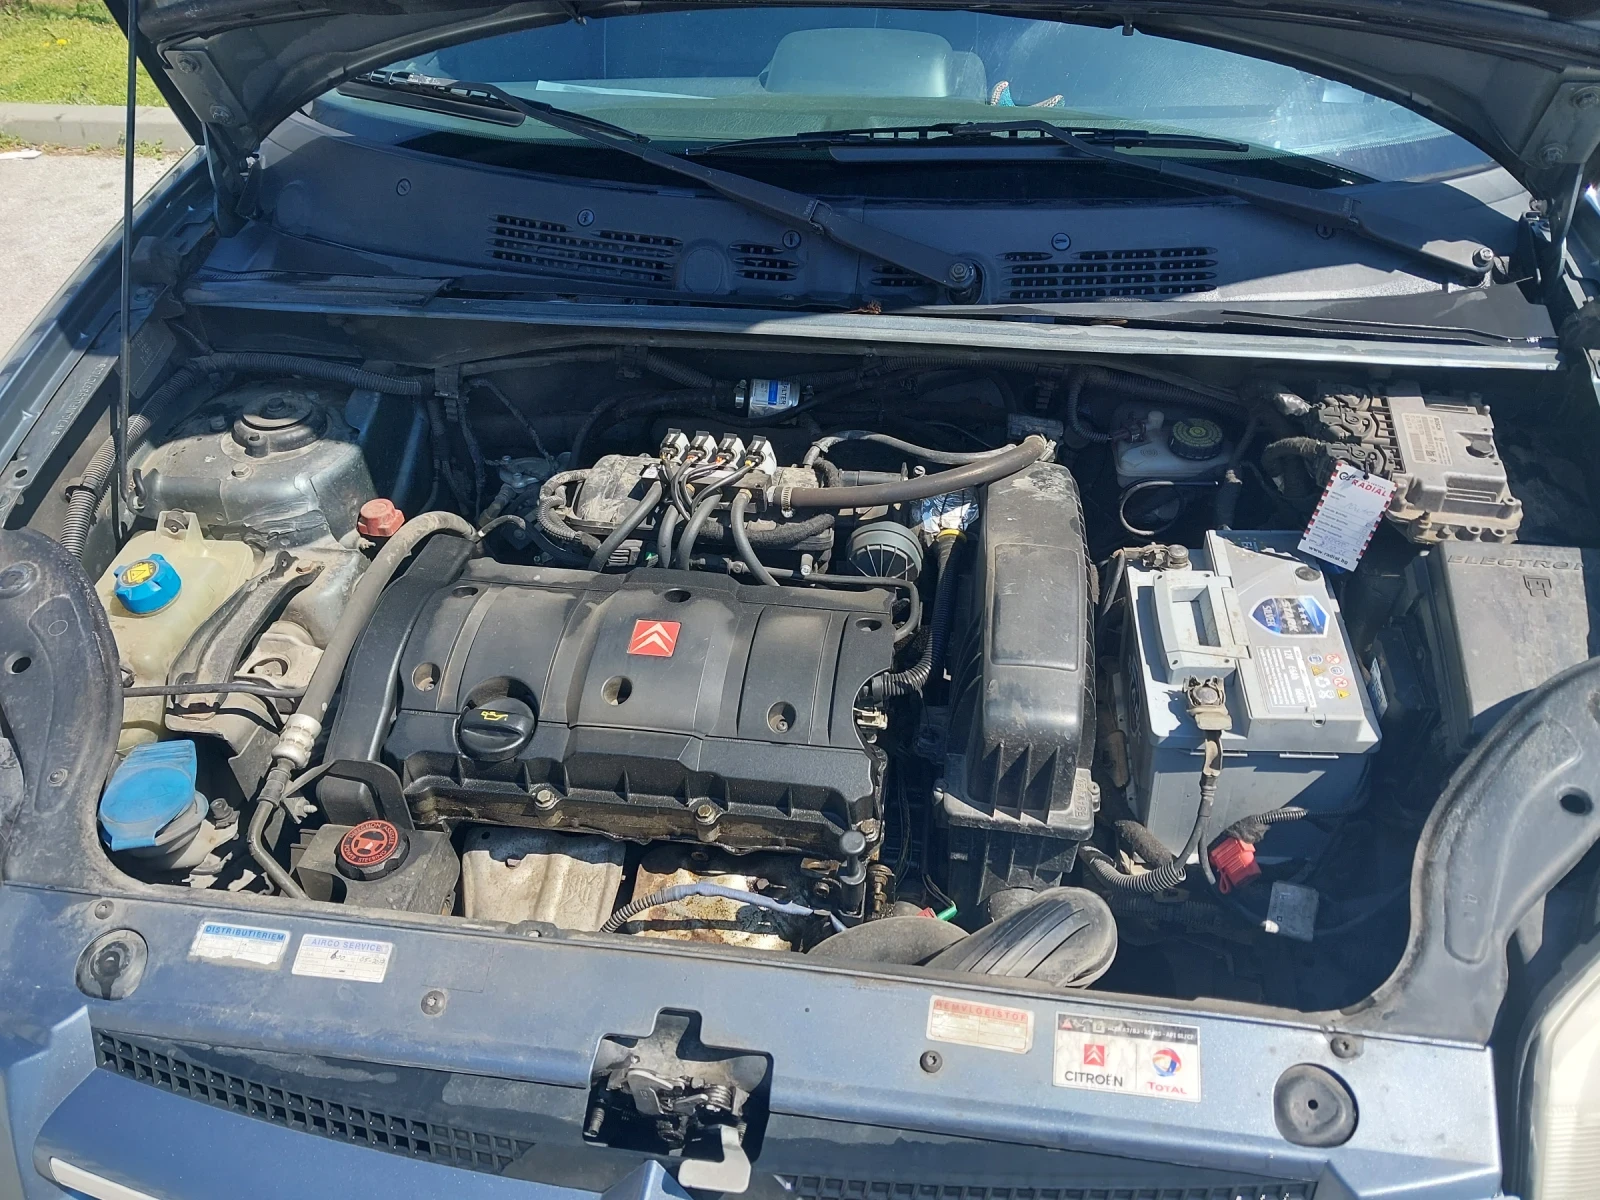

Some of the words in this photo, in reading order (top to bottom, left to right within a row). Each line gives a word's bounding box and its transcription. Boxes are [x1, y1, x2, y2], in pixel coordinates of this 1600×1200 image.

[1351, 479, 1388, 497] RADIAL
[1308, 546, 1349, 566] www.radial.bg
[1262, 605, 1277, 628] SILVER
[1281, 598, 1300, 633] STARK
[205, 925, 285, 941] DISTRIBUTIERIEM
[312, 938, 340, 948] AIRCO
[343, 941, 382, 952] SERVICE
[936, 1002, 1026, 1021] REMVLOEISTOF
